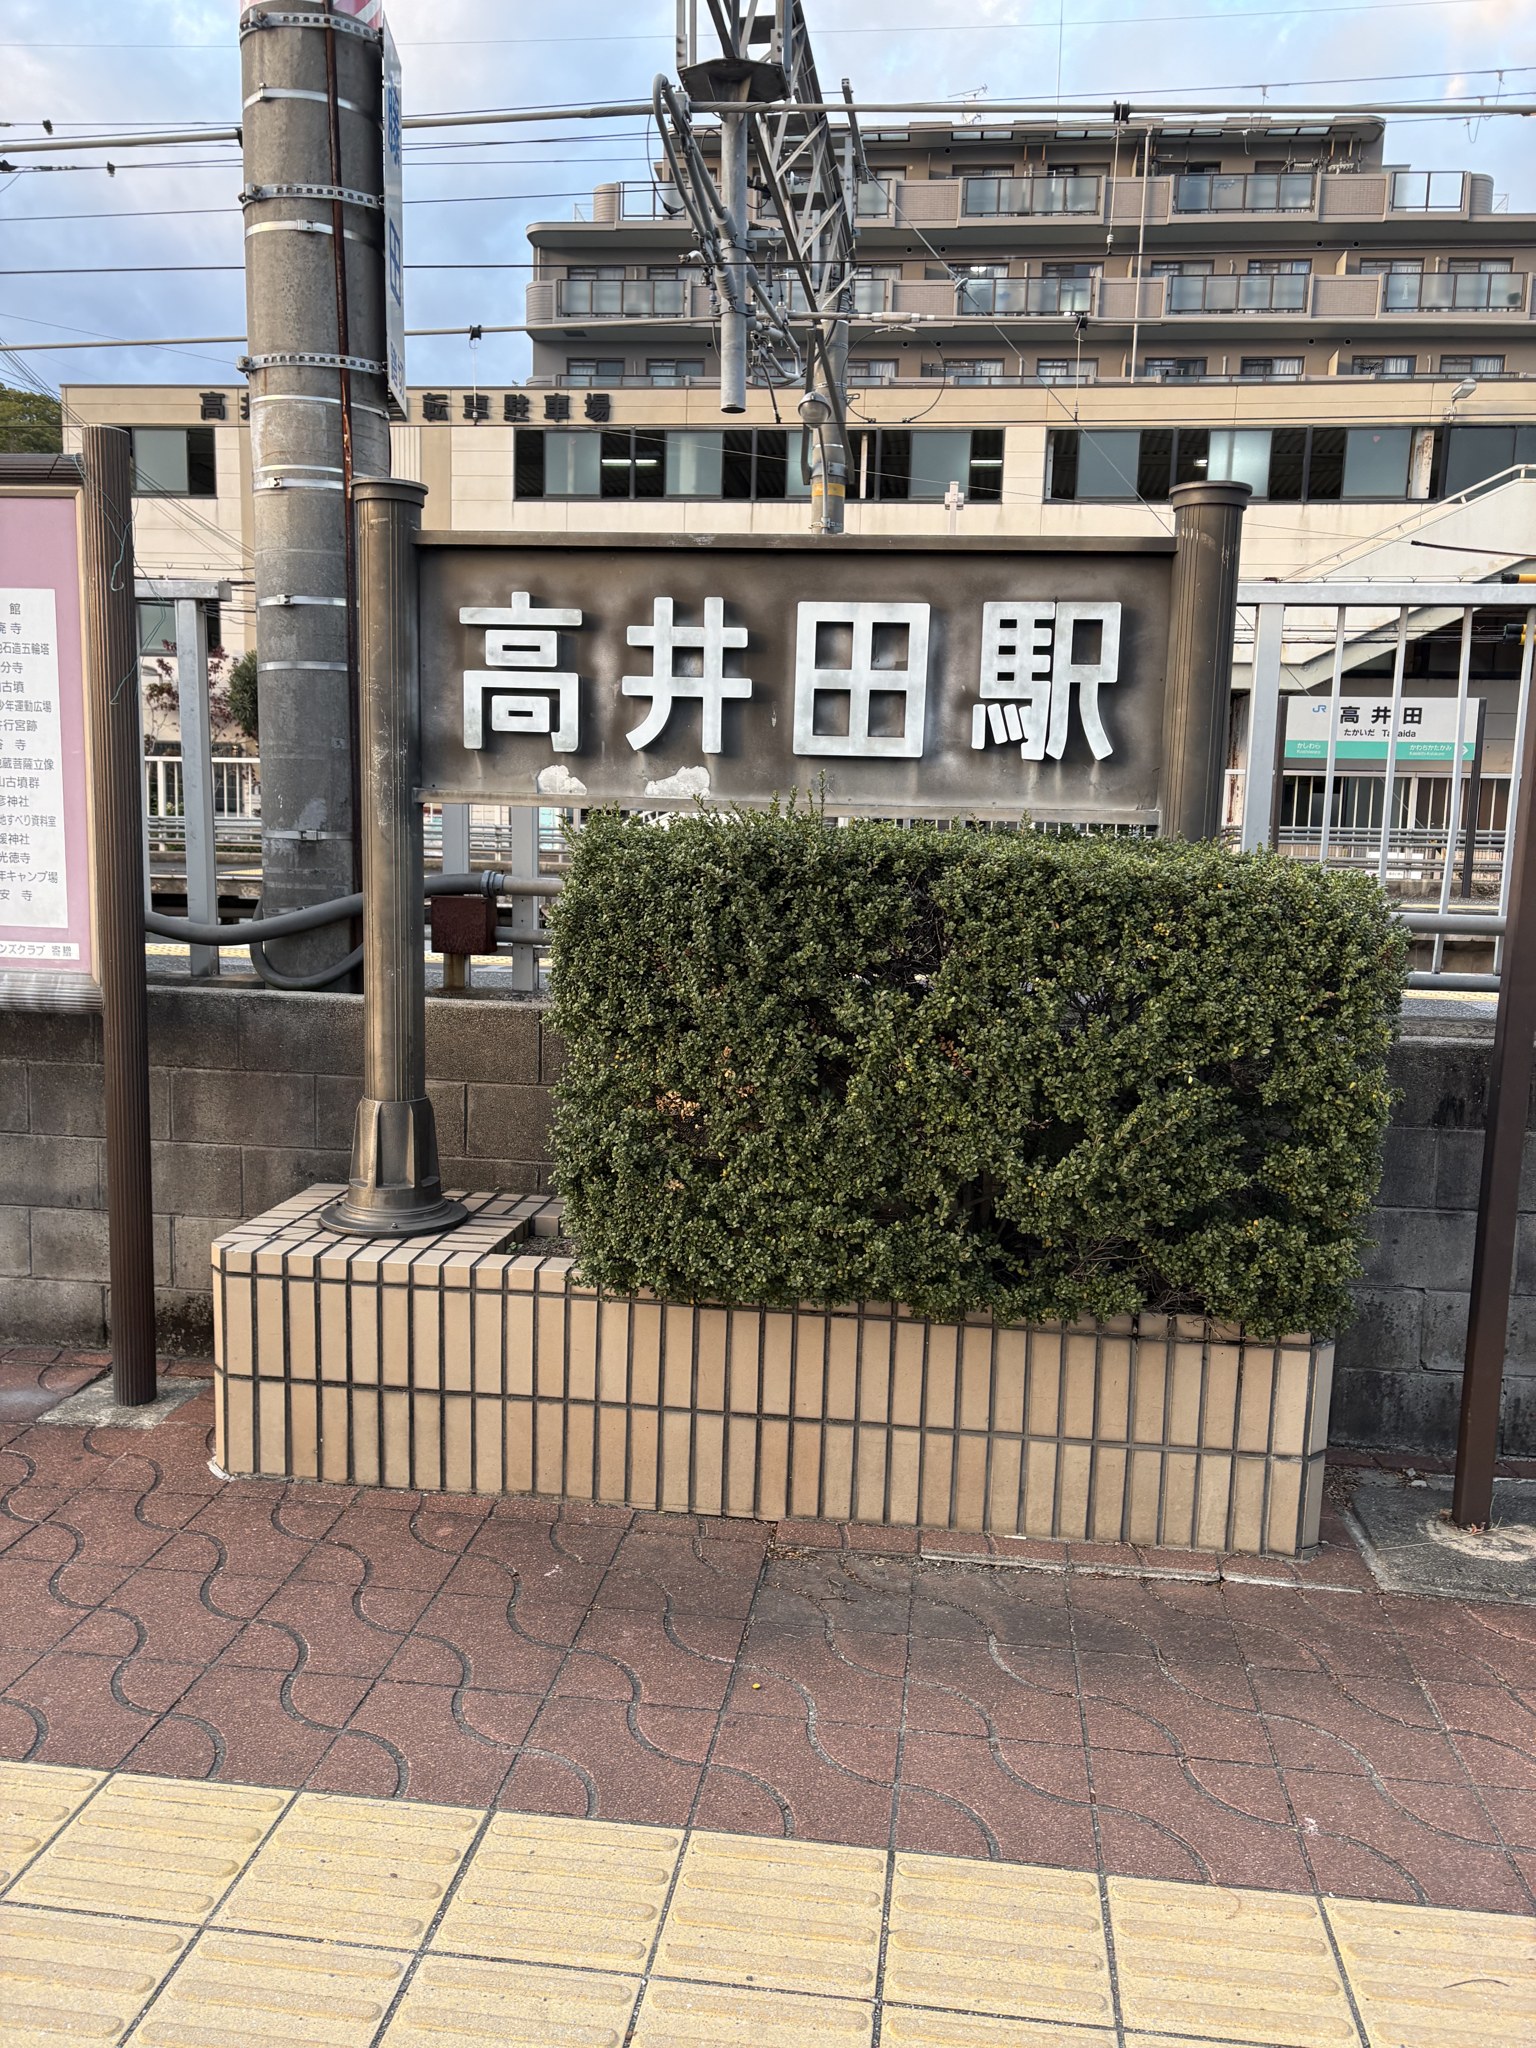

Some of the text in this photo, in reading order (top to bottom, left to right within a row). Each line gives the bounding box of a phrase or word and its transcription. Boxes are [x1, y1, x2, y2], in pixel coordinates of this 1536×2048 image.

[457, 590, 1123, 761] 高井田駅
[0, 680, 25, 694] 古墳
[1312, 704, 1327, 713] JR
[1340, 705, 1423, 725] 高井田
[0, 719, 38, 732] 行宮跡
[1343, 728, 1417, 738] たかいだ Taida
[0, 757, 54, 771] 蔵菩薩立像
[0, 851, 31, 865] 光徳寺
